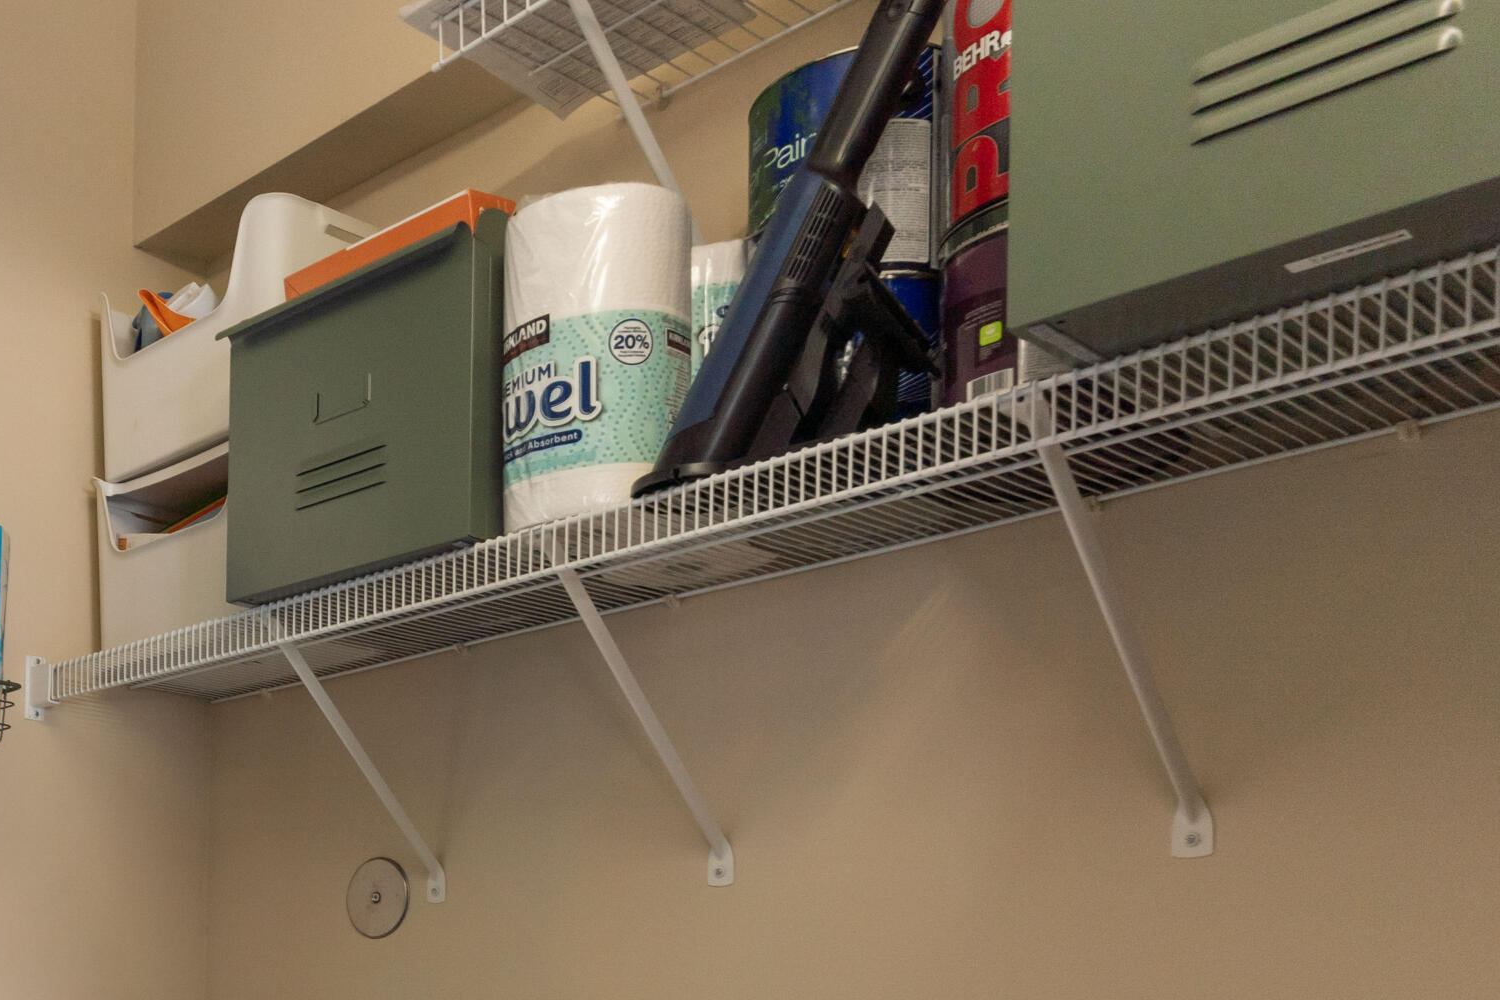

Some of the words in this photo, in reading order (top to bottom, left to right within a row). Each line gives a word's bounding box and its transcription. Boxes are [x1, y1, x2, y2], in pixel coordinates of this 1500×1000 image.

[953, 31, 1000, 81] BEHR
[613, 334, 650, 350] 20%
[505, 363, 552, 398] EMIUM
[505, 360, 597, 438] wel
[527, 433, 578, 450] Absorbent
